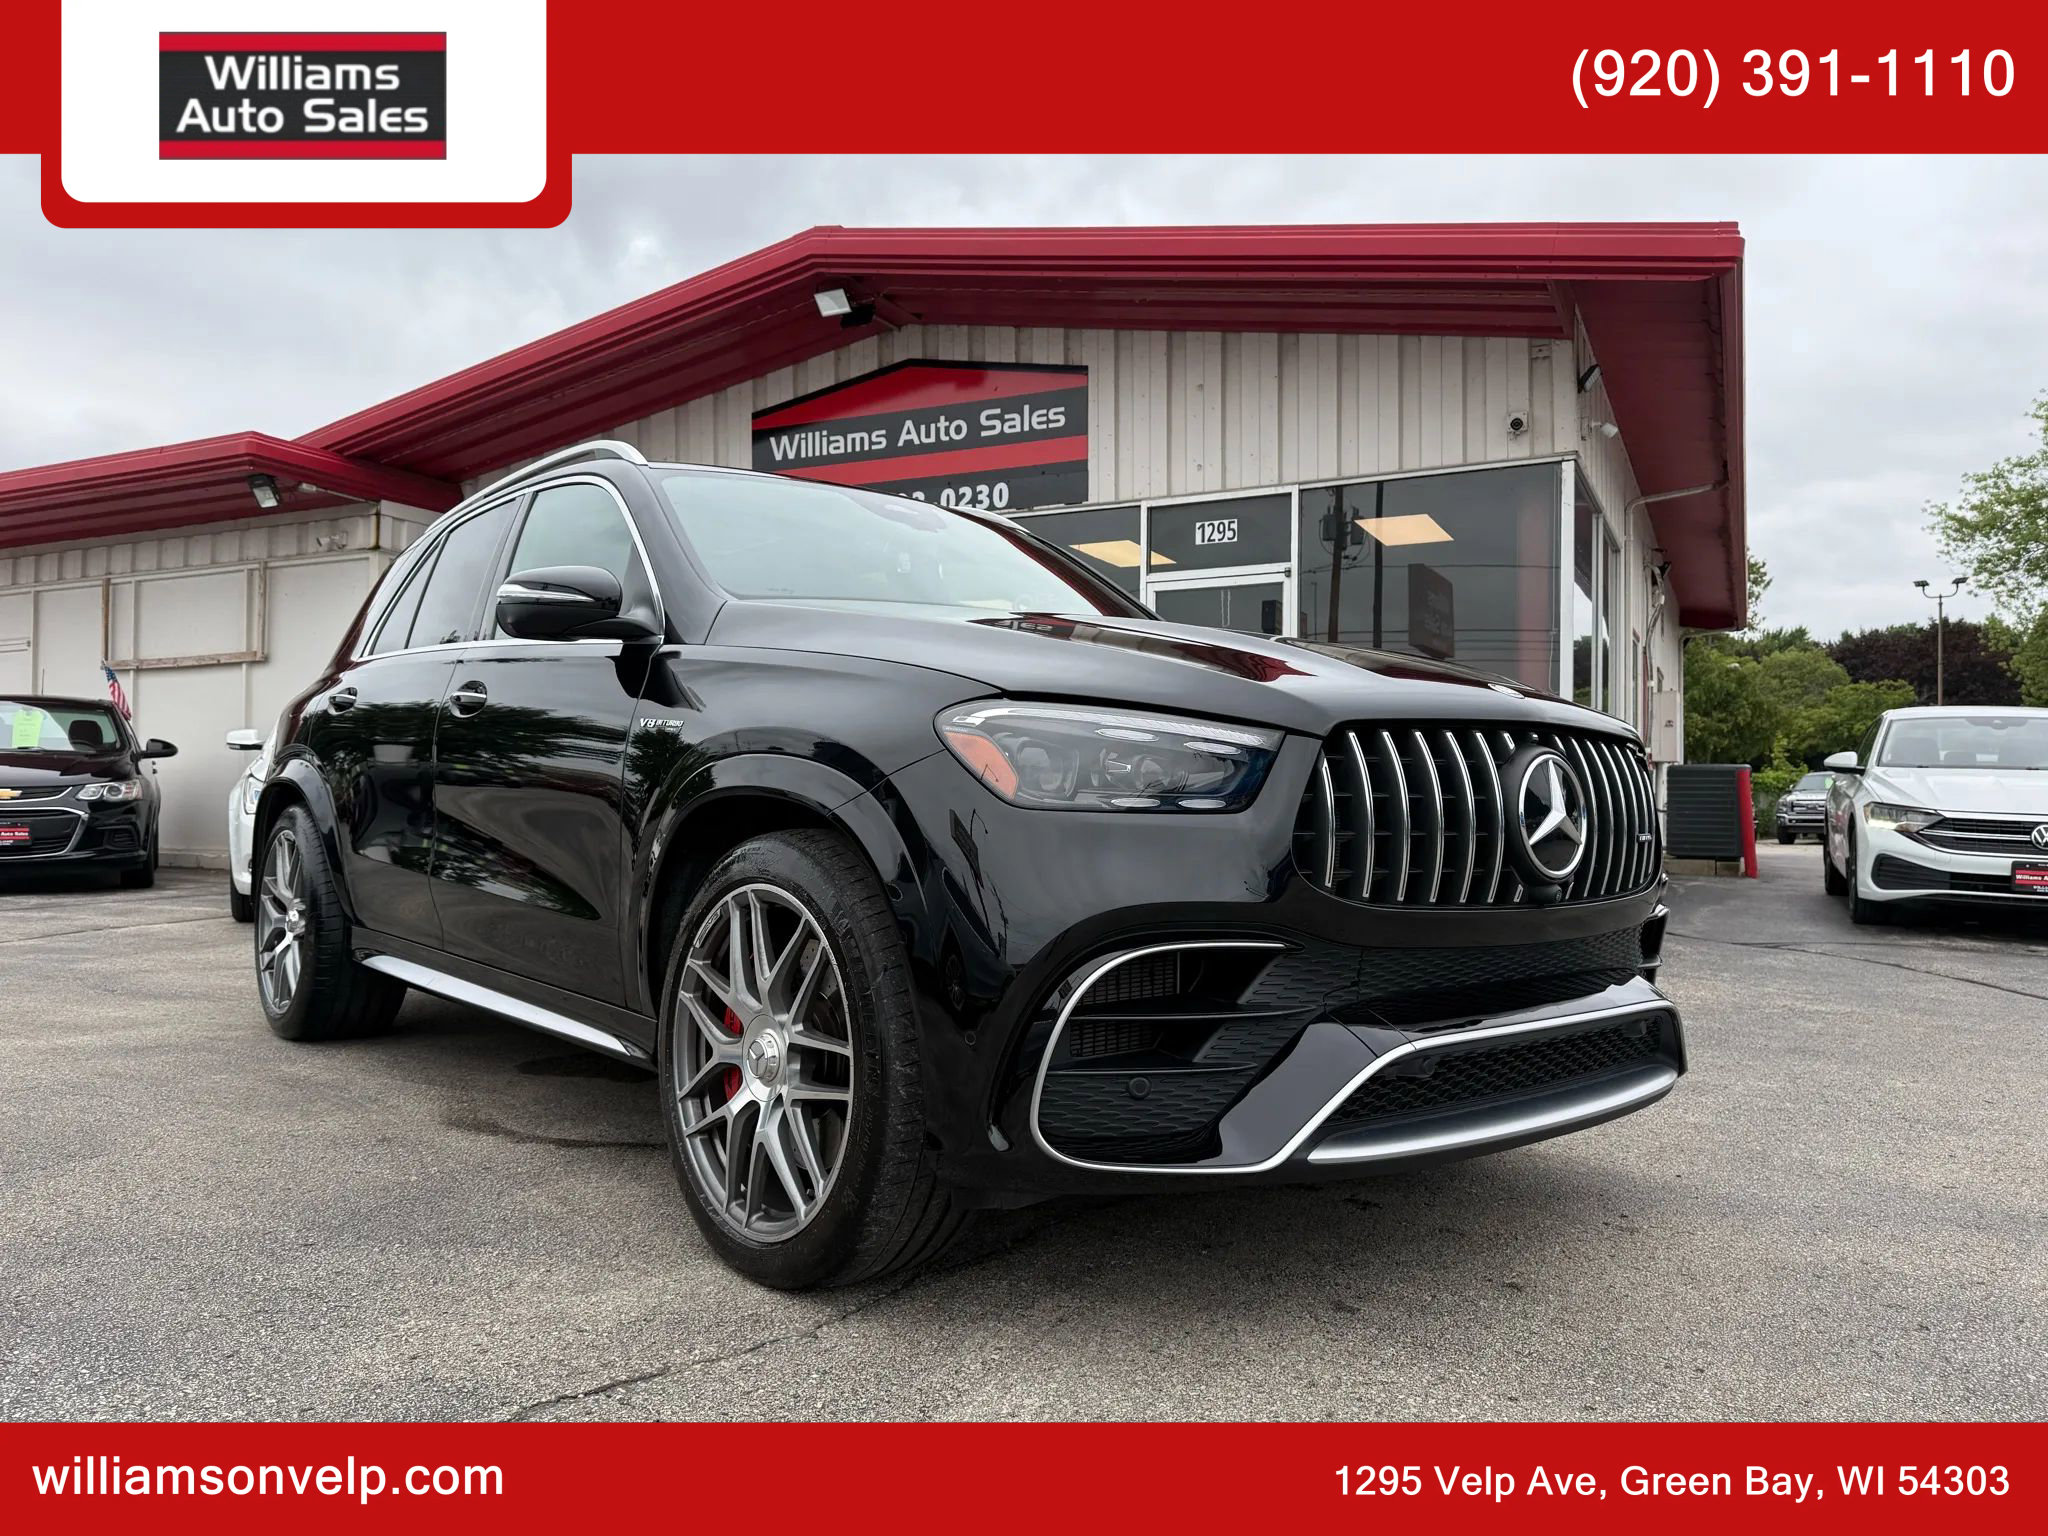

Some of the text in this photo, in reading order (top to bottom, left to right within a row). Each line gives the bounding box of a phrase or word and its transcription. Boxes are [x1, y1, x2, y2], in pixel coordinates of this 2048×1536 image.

[769, 404, 1066, 461] Williams Auto Sales
[1197, 520, 1236, 543] 1295
[640, 718, 656, 728] V8
